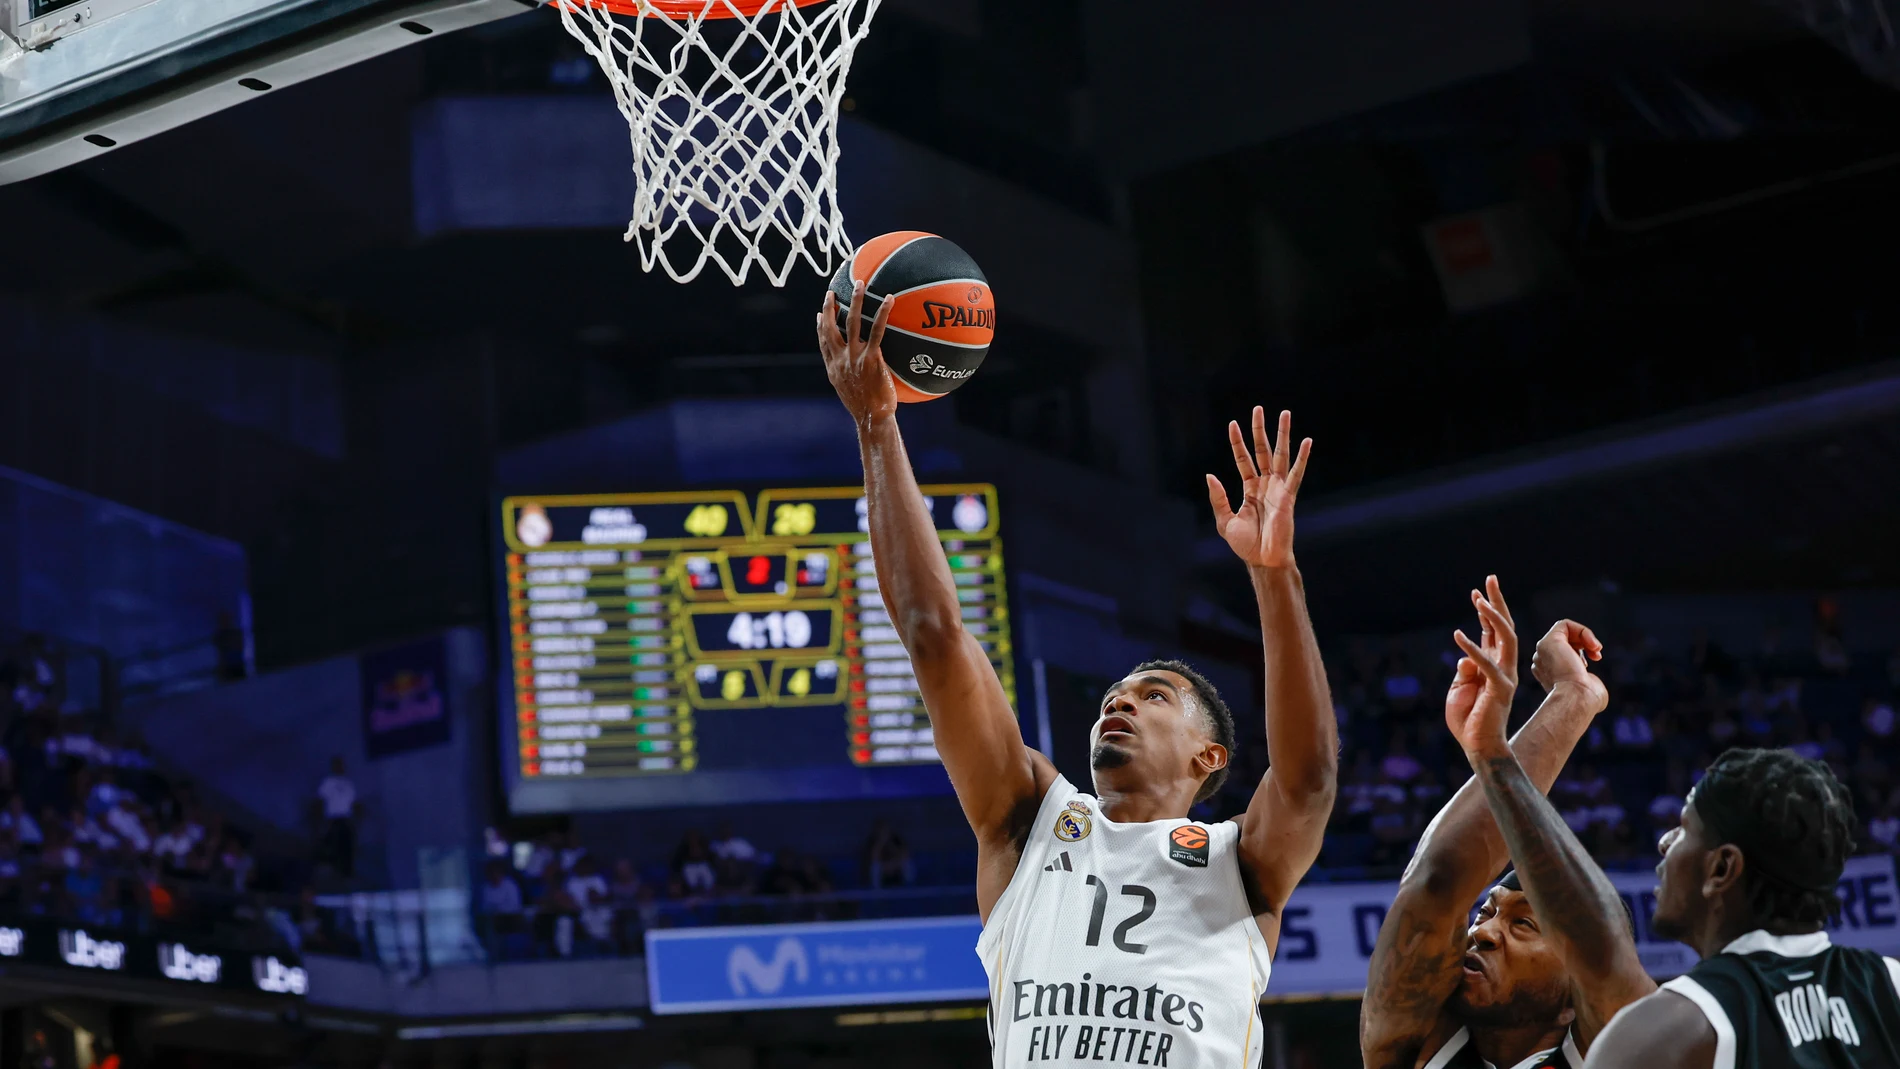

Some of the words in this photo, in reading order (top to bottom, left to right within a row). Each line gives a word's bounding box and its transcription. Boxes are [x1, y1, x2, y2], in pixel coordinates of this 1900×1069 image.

[727, 610, 812, 649] 4:19
[787, 668, 812, 697] 4
[1085, 874, 1157, 955] 12
[58, 929, 125, 970] Uber
[157, 942, 222, 983] Uber
[1013, 972, 1204, 1033] Emirates
[1028, 1025, 1069, 1062] FLY
[1074, 1025, 1174, 1068] BETTER
